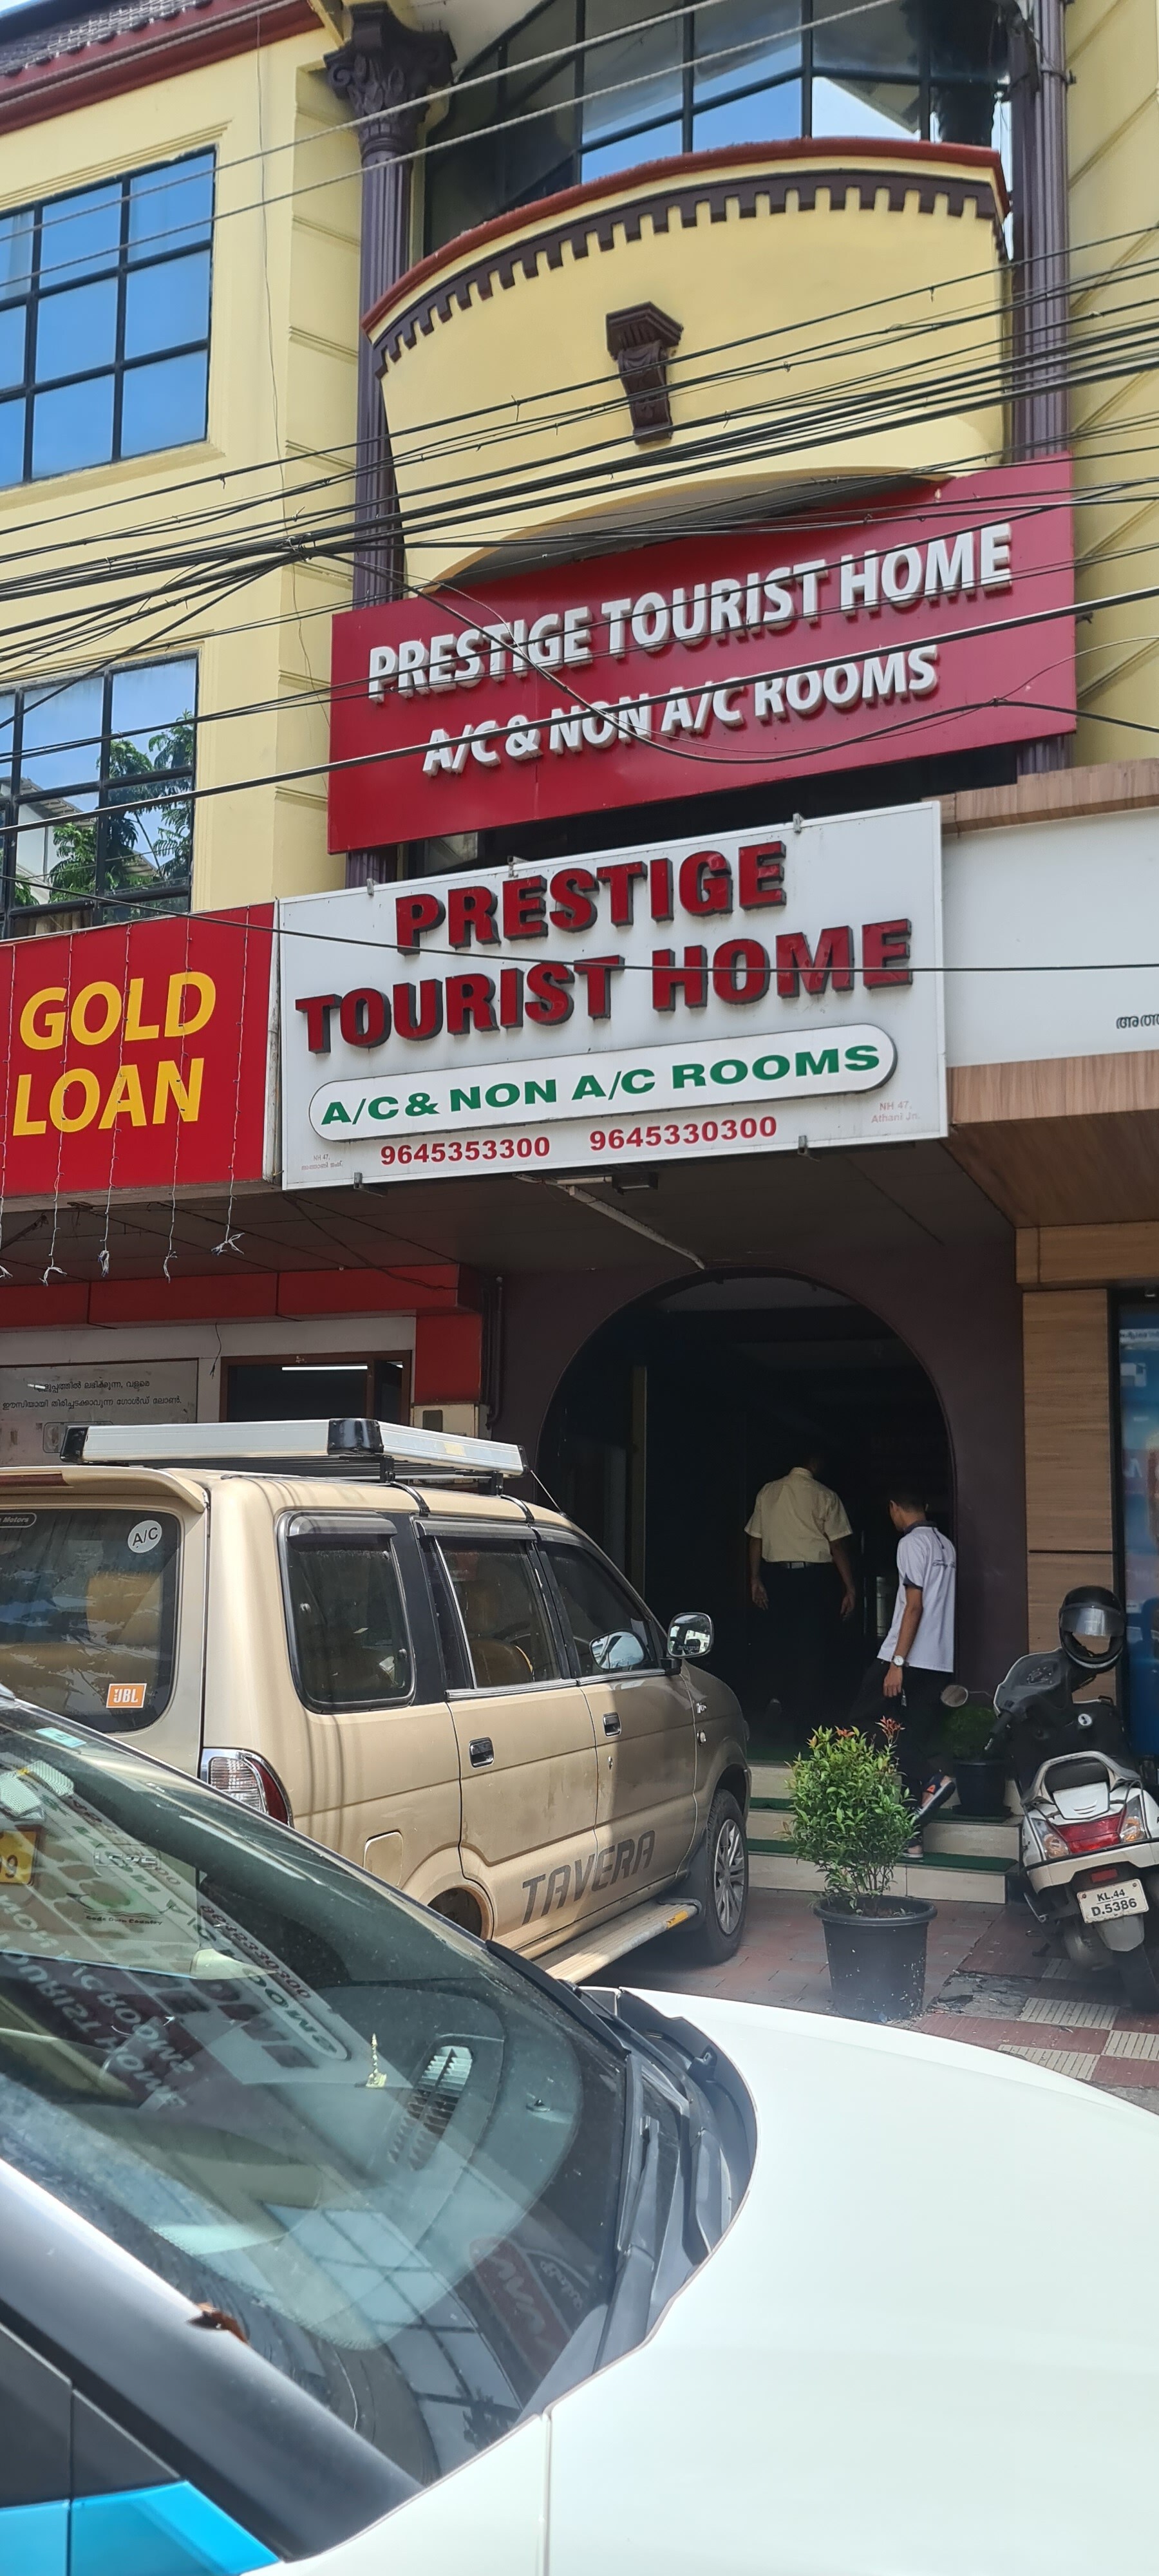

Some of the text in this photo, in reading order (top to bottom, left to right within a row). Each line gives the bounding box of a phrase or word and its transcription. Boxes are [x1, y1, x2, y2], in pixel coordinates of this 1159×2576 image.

[368, 523, 1012, 703] PRESTIGE TOURIST HOME
[422, 644, 940, 775] A/C & NON A/C ROOMS
[395, 840, 787, 956] PRESTIGE
[19, 971, 216, 1050] GOLD
[295, 918, 913, 1054] TOURIST HOME
[13, 1057, 205, 1136] LOAN
[449, 1079, 558, 1113] NON
[571, 1068, 656, 1102] A/C
[672, 1045, 881, 1091] ROOMS
[879, 1101, 894, 1111] NH
[380, 1116, 778, 1166] 9645353300 9645330300
[871, 1112, 903, 1123] Athani
[132, 1526, 158, 1547] A/C
[113, 1688, 138, 1703] JBL
[522, 1829, 655, 1926] TAVERA
[1091, 1898, 1137, 1917] D.5386
[1097, 1889, 1126, 1902] KL.44
